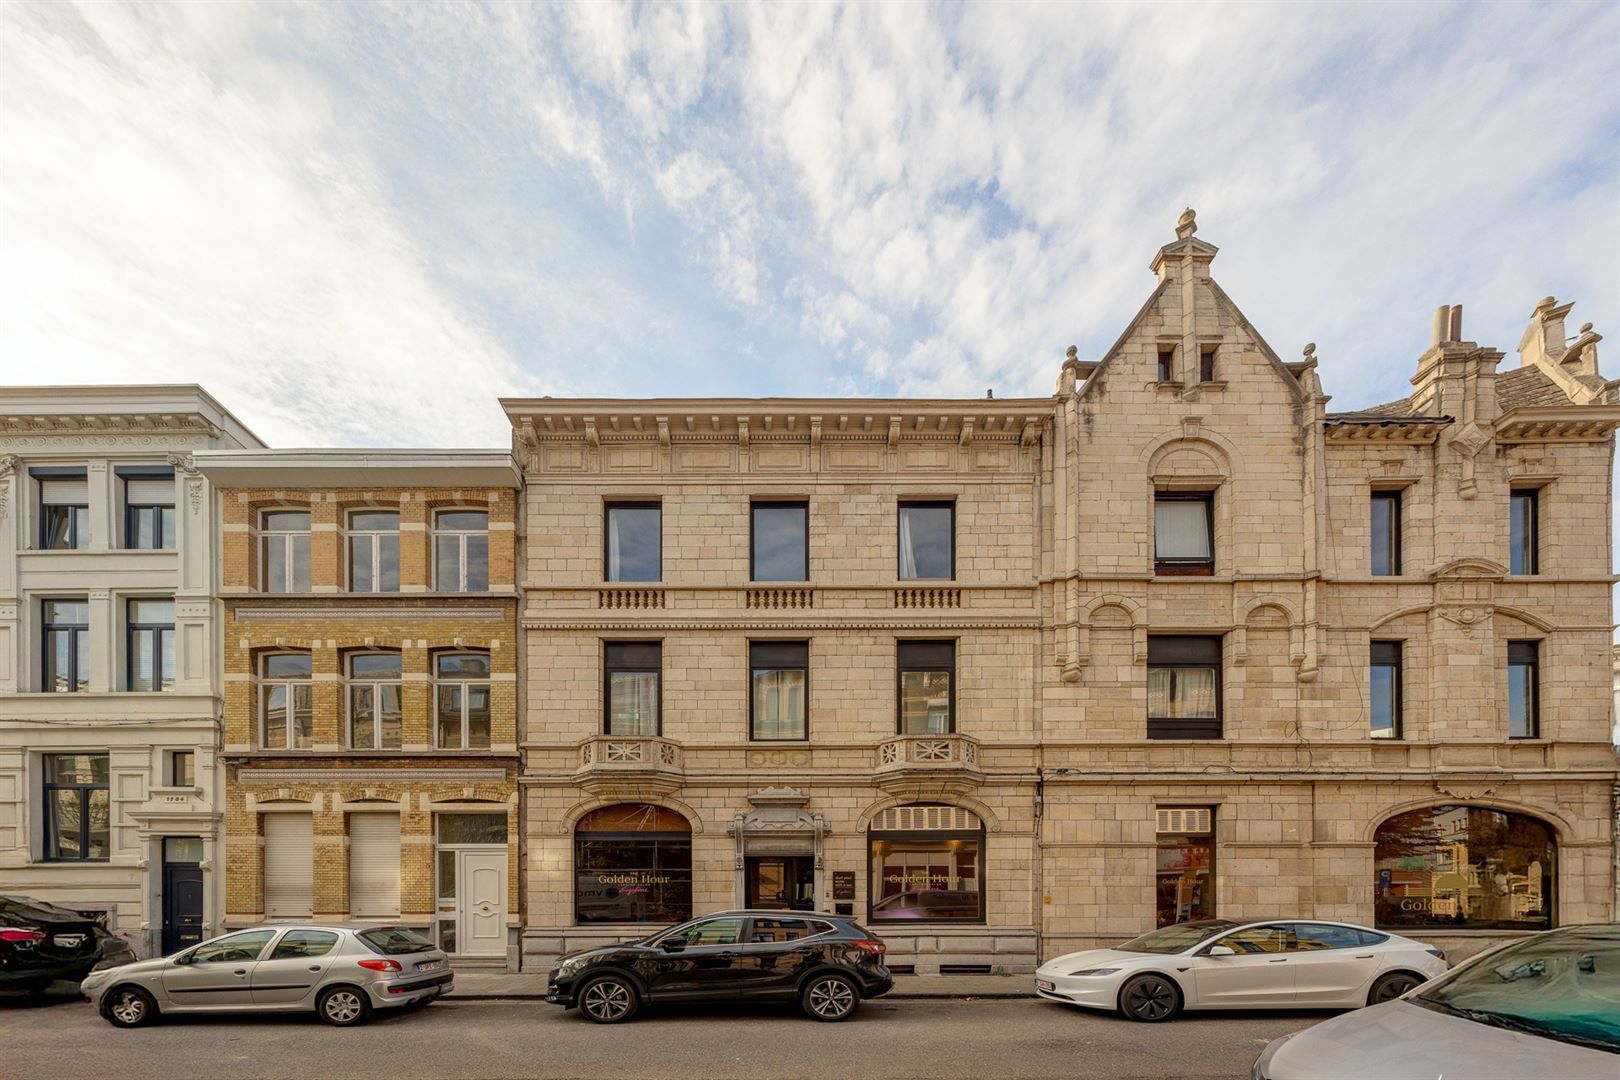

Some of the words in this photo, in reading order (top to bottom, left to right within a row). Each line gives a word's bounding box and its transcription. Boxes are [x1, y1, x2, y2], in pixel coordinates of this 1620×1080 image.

[598, 874, 638, 884] Golden
[641, 875, 670, 884] Hour
[889, 874, 929, 884] Golden
[933, 874, 962, 883] Hour
[1401, 898, 1457, 911] Golden
